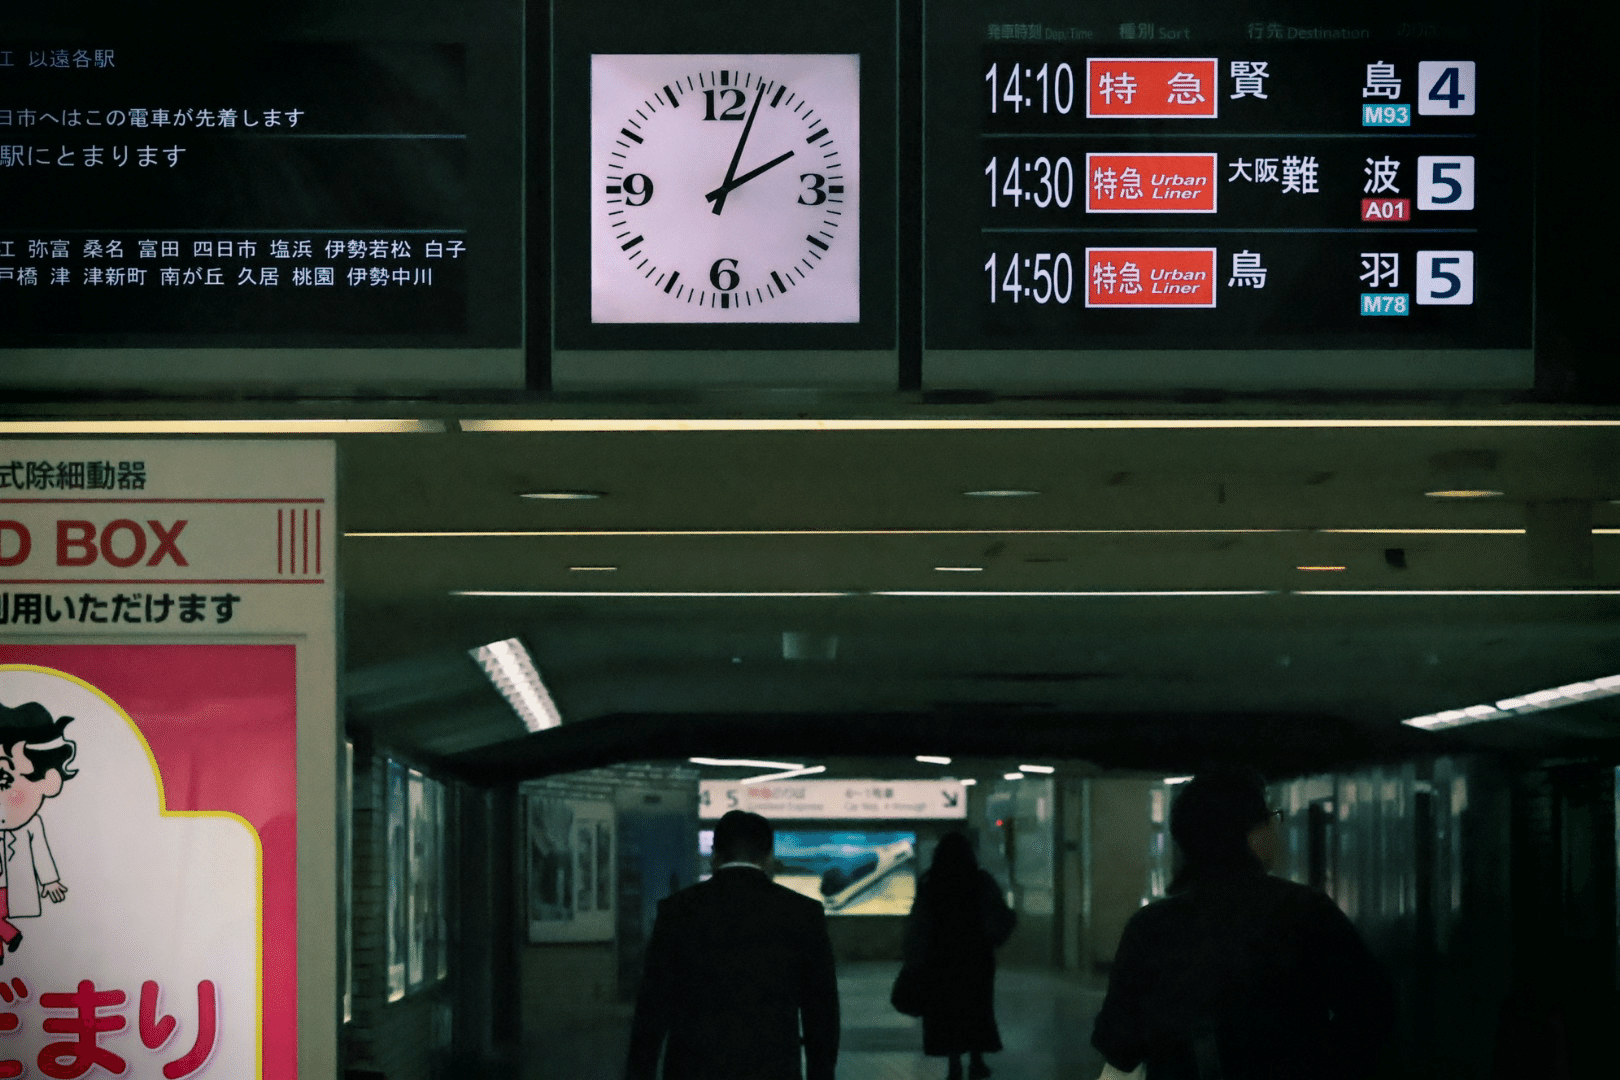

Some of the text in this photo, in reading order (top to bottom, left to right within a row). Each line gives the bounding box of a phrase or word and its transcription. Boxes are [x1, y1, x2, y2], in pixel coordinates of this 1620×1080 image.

[1119, 23, 1191, 41] 種別 Sort
[1248, 22, 1370, 41] 行先 Destination
[28, 48, 115, 68] 以遠各駅
[985, 63, 1074, 114] 14:10
[1428, 67, 1466, 109] 4
[702, 88, 747, 121] 12
[1364, 106, 1410, 124] M93
[0, 108, 305, 128] 日市へはこの電車が先着します
[0, 144, 187, 168] 駅にとまります
[622, 173, 654, 207] 9
[797, 173, 827, 206] 3
[985, 157, 1074, 208] 14:30
[1093, 166, 1144, 200] 特急
[1150, 174, 1207, 187] Urban
[1430, 162, 1463, 204] 5
[1151, 187, 1202, 200] Liner
[1365, 201, 1405, 219] A01
[28, 239, 70, 259] 弥富
[83, 239, 124, 259] 桑名
[138, 239, 179, 259] 富田
[193, 240, 257, 259] 四日市
[269, 239, 313, 259] 塩浜
[325, 239, 411, 259] 伊勢若松
[425, 239, 467, 259] 白子
[50, 266, 70, 286] 津
[83, 266, 148, 286] 津新町
[160, 266, 225, 286] 南が丘
[237, 266, 280, 286] 久居
[292, 266, 334, 287] 桃園
[346, 266, 432, 287] 伊勢中川
[709, 258, 740, 291] 6
[984, 252, 1073, 304] 14:50
[1092, 261, 1143, 295] 特急
[1150, 269, 1206, 282] Urban
[1429, 257, 1462, 299] 5
[1150, 281, 1201, 295] Liner
[1362, 296, 1408, 314] M78
[0, 460, 147, 491] 式除細動器
[56, 518, 190, 568] BOX
[726, 789, 739, 808] 5
